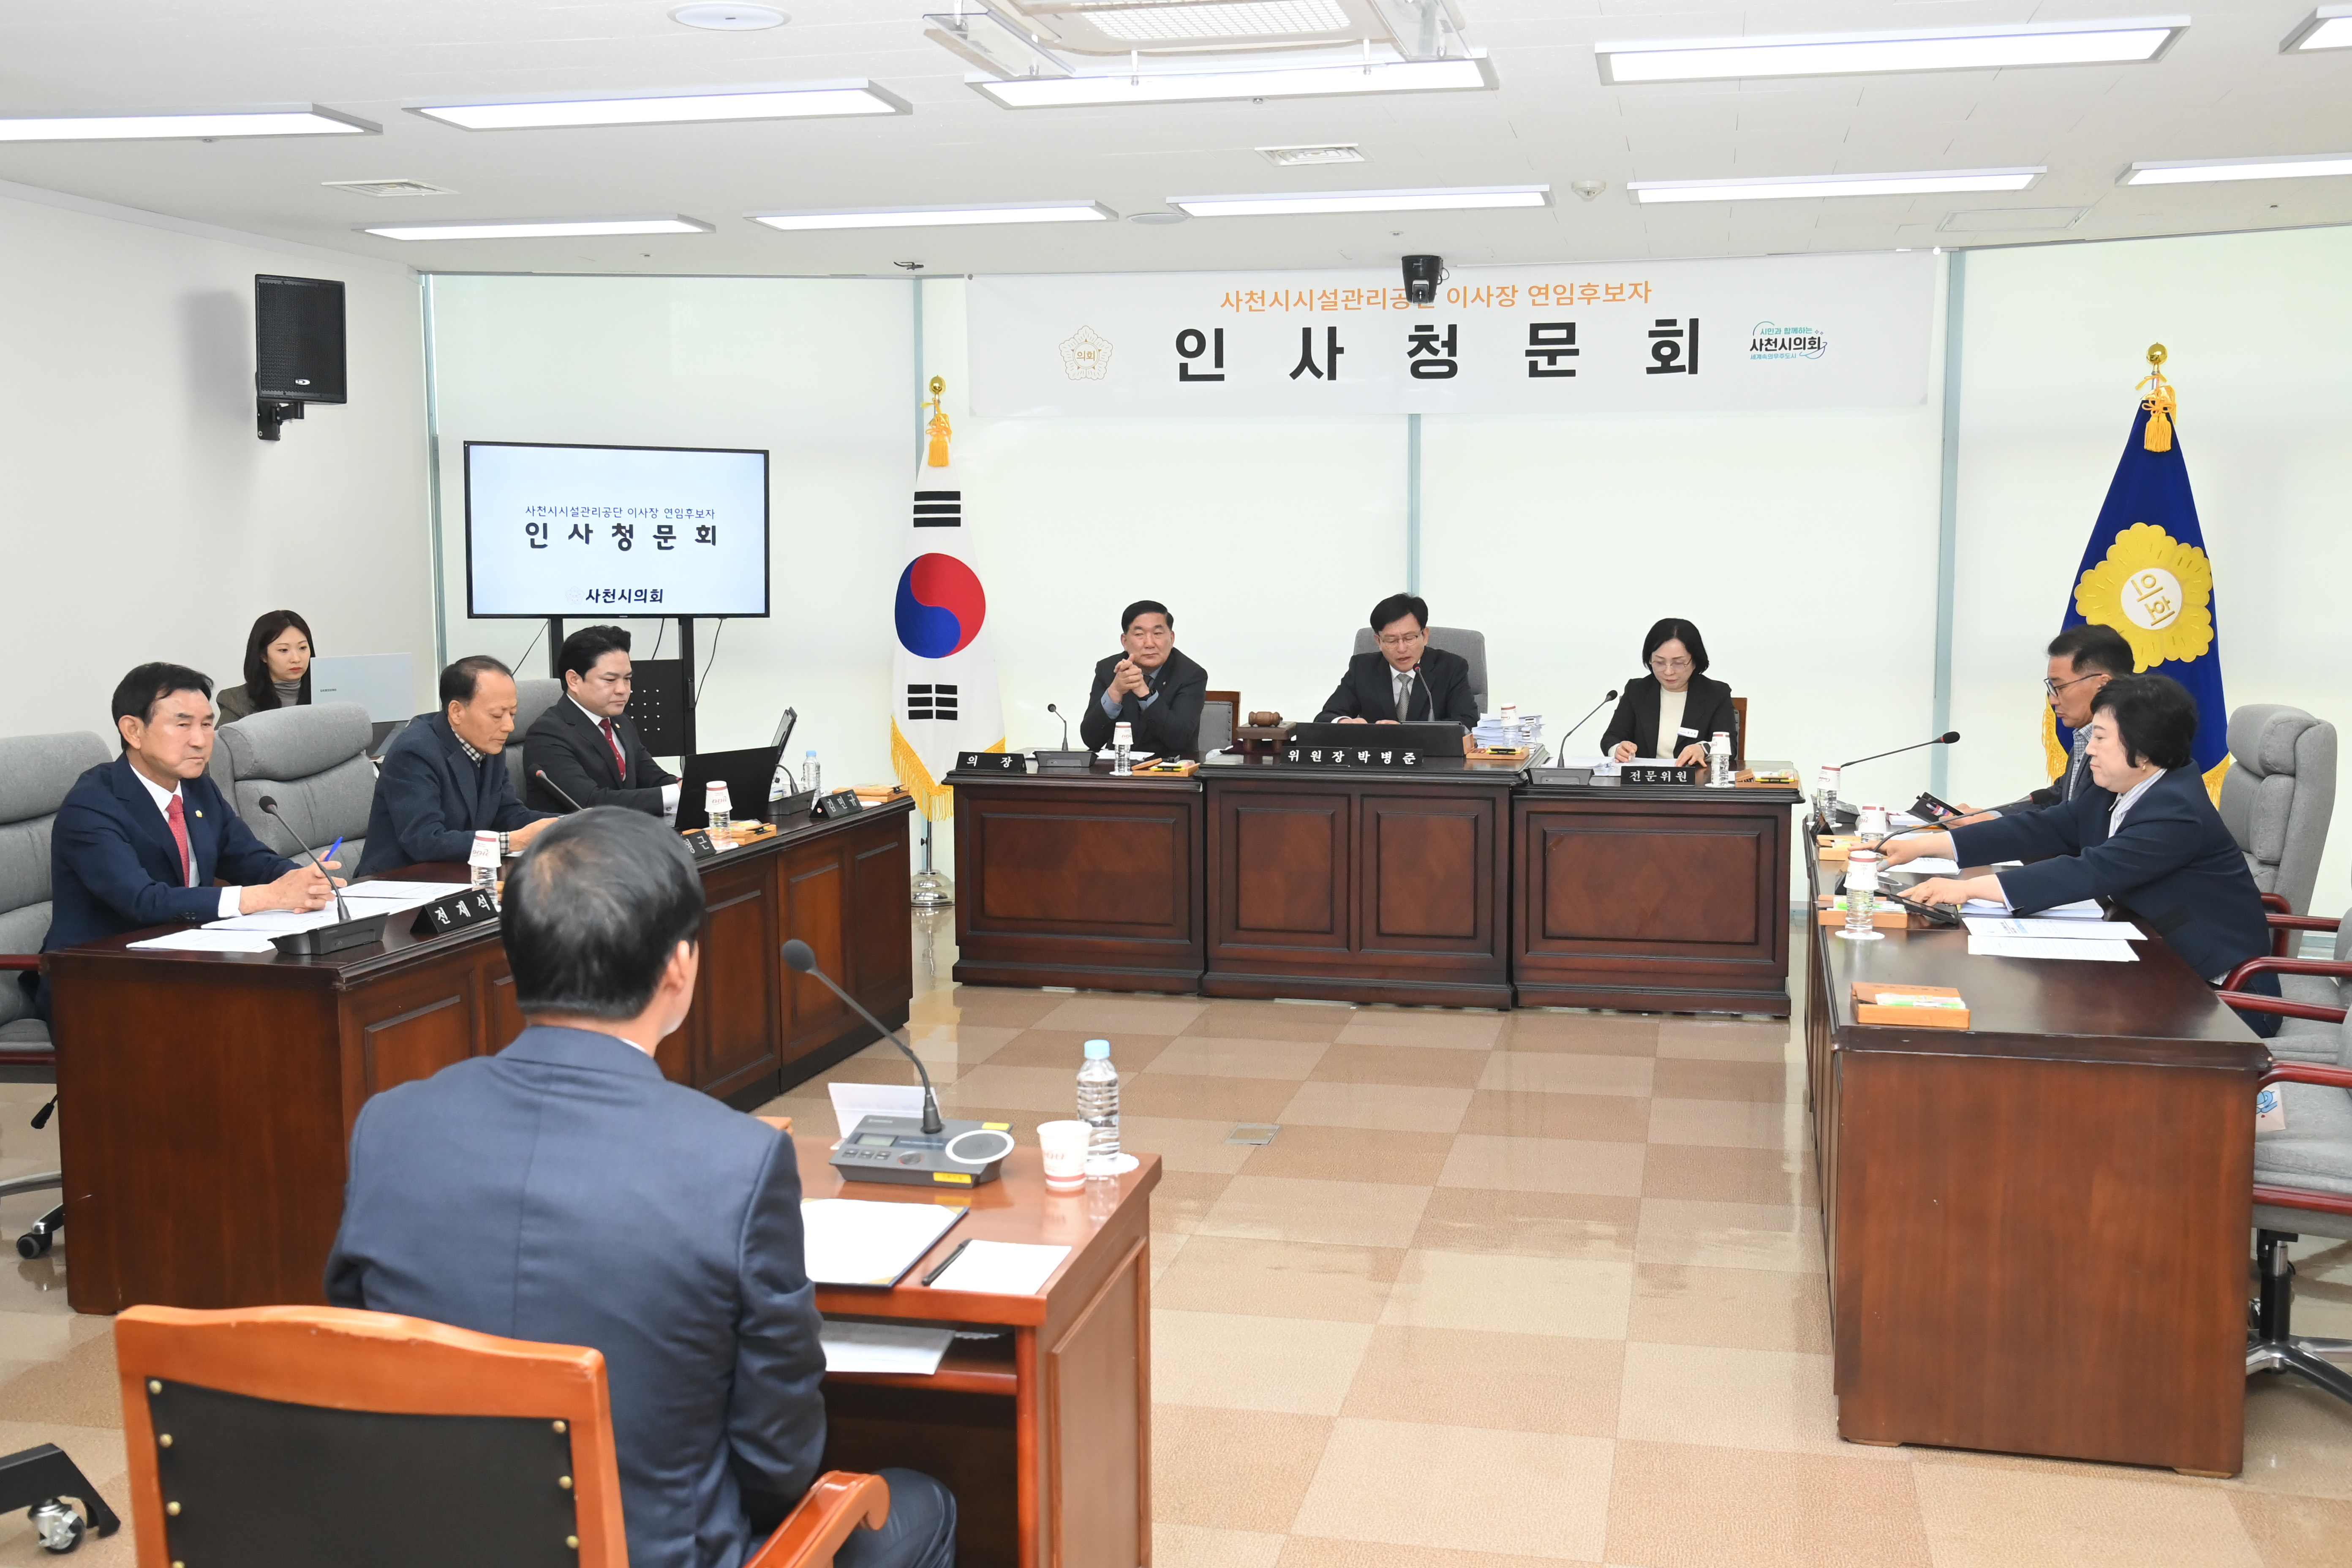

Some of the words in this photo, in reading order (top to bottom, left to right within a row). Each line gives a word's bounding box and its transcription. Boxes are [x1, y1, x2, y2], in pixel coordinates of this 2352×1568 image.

[1220, 287, 1435, 313] 사천시시설관리공
[1447, 284, 1519, 308] 이사장
[1528, 280, 1653, 306] 연임후보자
[1784, 327, 1813, 335] 함께하는
[1750, 336, 1821, 351] 사천시의회
[1076, 350, 1095, 361] 의회
[525, 505, 623, 518] 사천시시설관리공단
[627, 507, 659, 519] 이사장
[664, 508, 715, 520] 연임후보자
[585, 588, 663, 604] 사천시의회
[966, 755, 1013, 768] 의장
[1288, 749, 1345, 763] 위원장
[1358, 750, 1416, 765] 박병준
[1629, 770, 1687, 782] 전문위원
[827, 794, 857, 812] 김민규
[683, 835, 710, 854] 형근
[434, 894, 490, 925] 전재석
